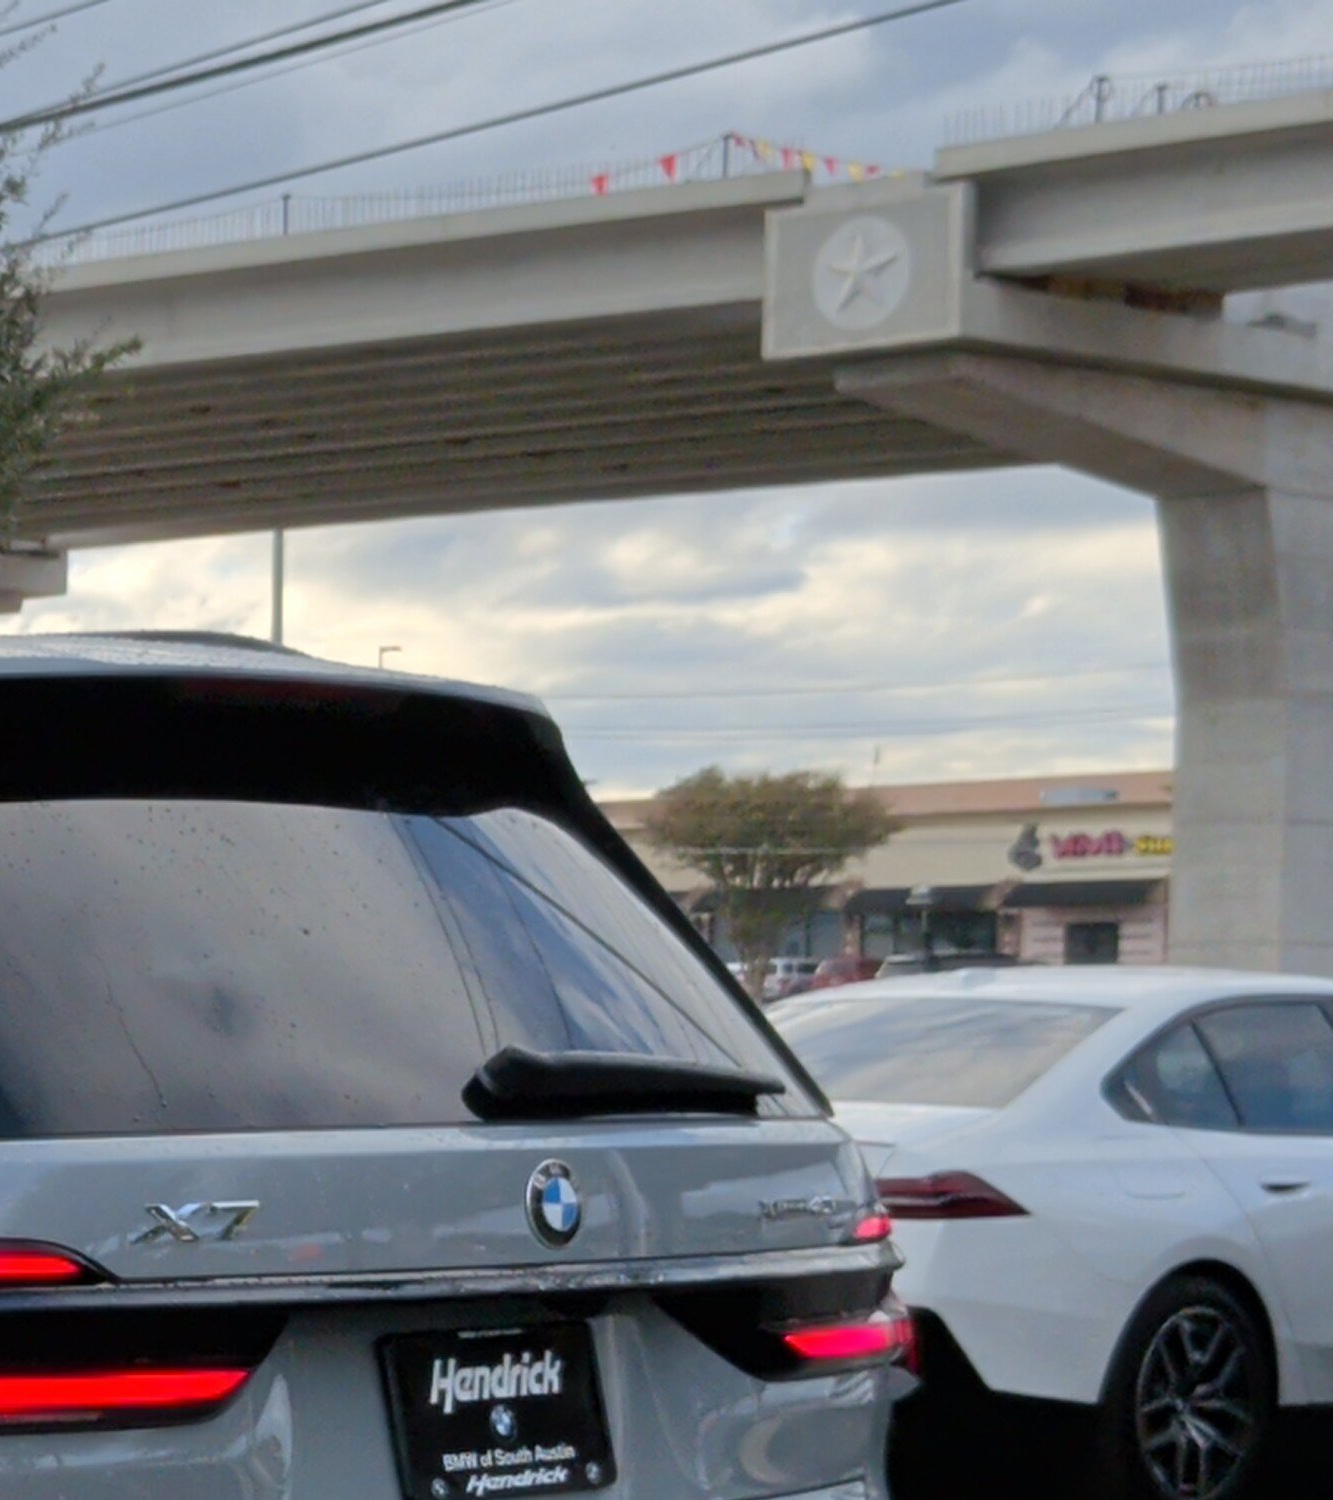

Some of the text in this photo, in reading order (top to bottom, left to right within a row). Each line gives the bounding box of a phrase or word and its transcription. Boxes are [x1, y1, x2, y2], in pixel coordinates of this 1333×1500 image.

[130, 1200, 260, 1243] X7
[430, 1350, 561, 1414] Hendrick
[442, 1443, 575, 1472] BMW of South Austin
[466, 1466, 568, 1497] Hendrick
